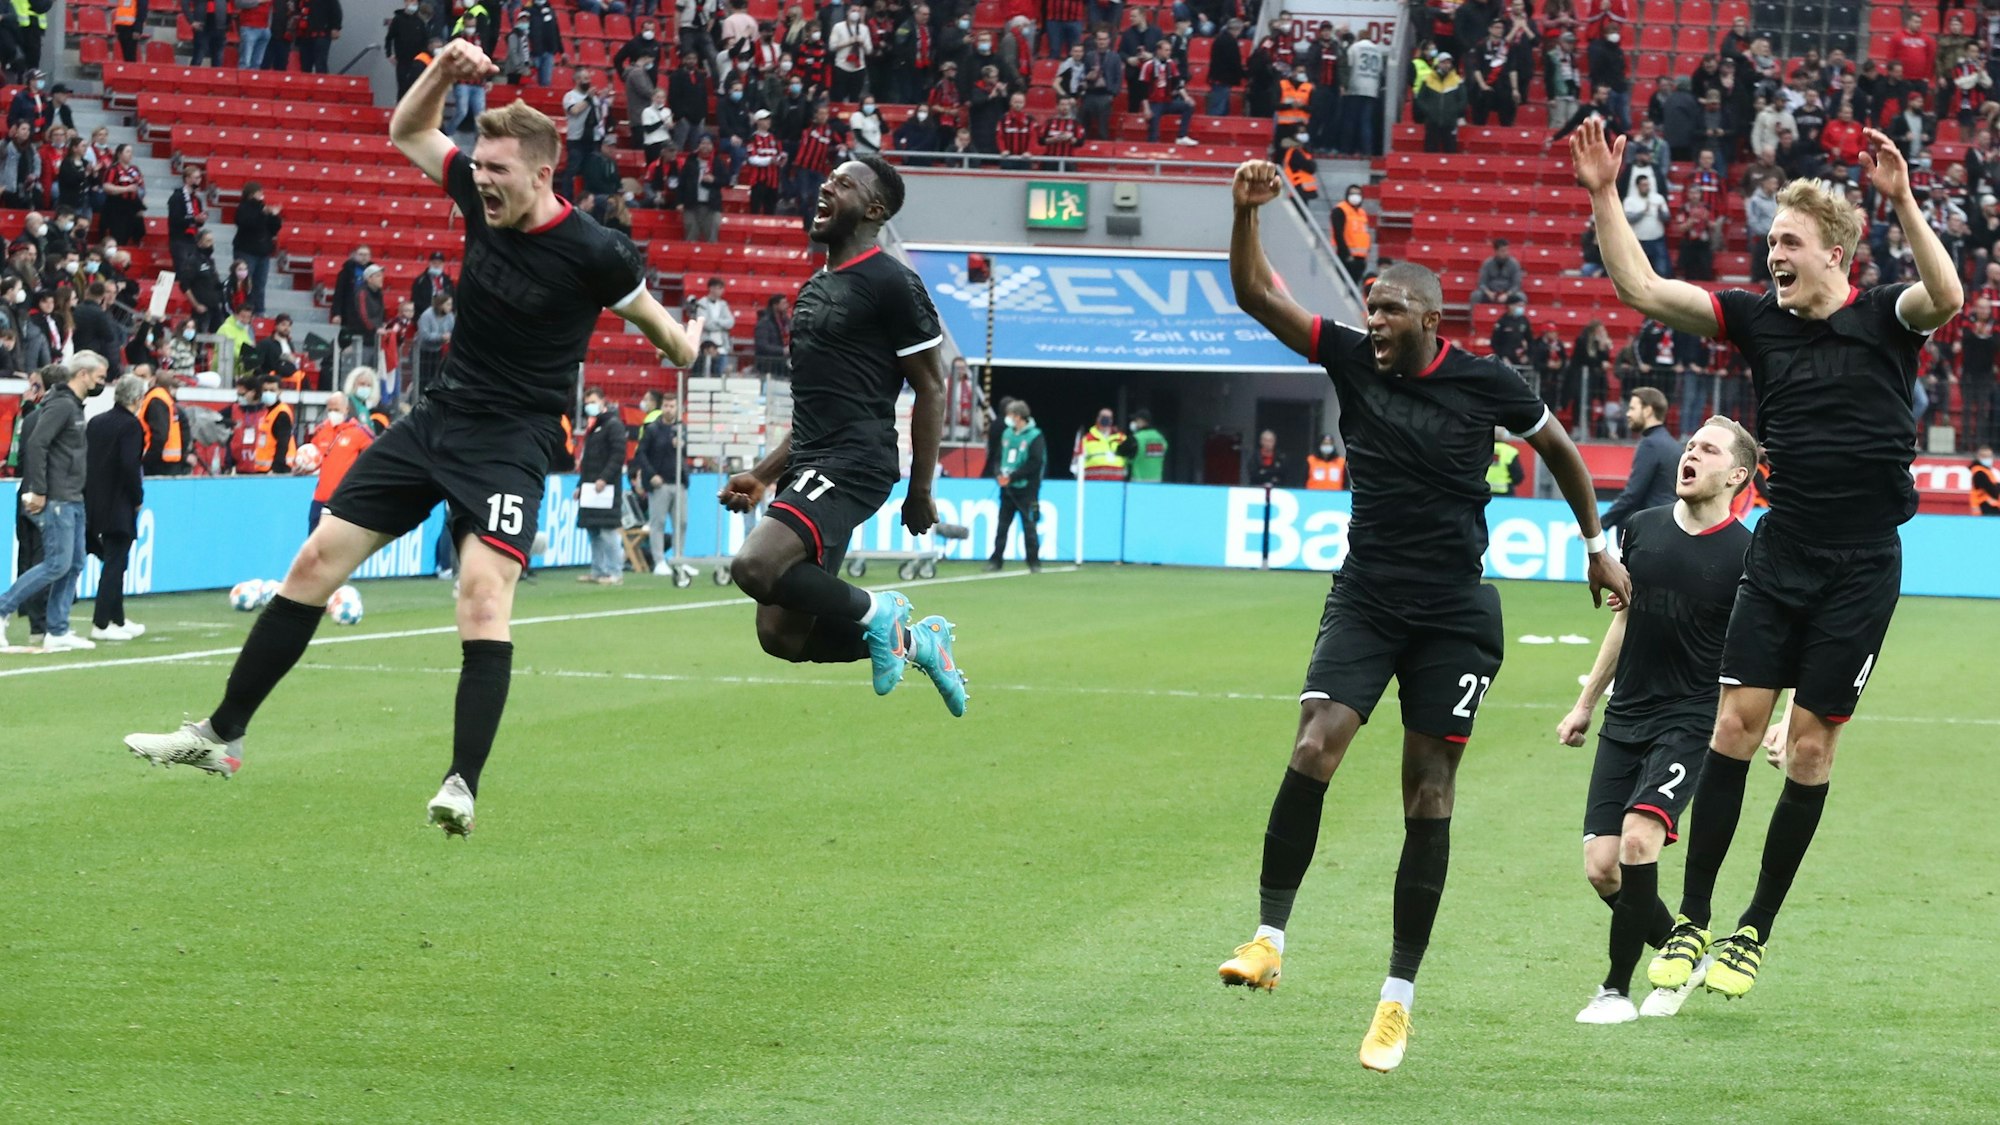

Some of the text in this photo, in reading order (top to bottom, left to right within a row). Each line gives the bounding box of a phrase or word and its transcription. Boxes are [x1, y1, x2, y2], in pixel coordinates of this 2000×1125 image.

[1046, 266, 1246, 315] EVL
[1130, 329, 1184, 342] Zeit
[1190, 329, 1226, 342] für
[793, 469, 836, 502] 17
[487, 493, 524, 536] 15
[1853, 653, 1875, 696] 4
[1657, 762, 1687, 800] 2
